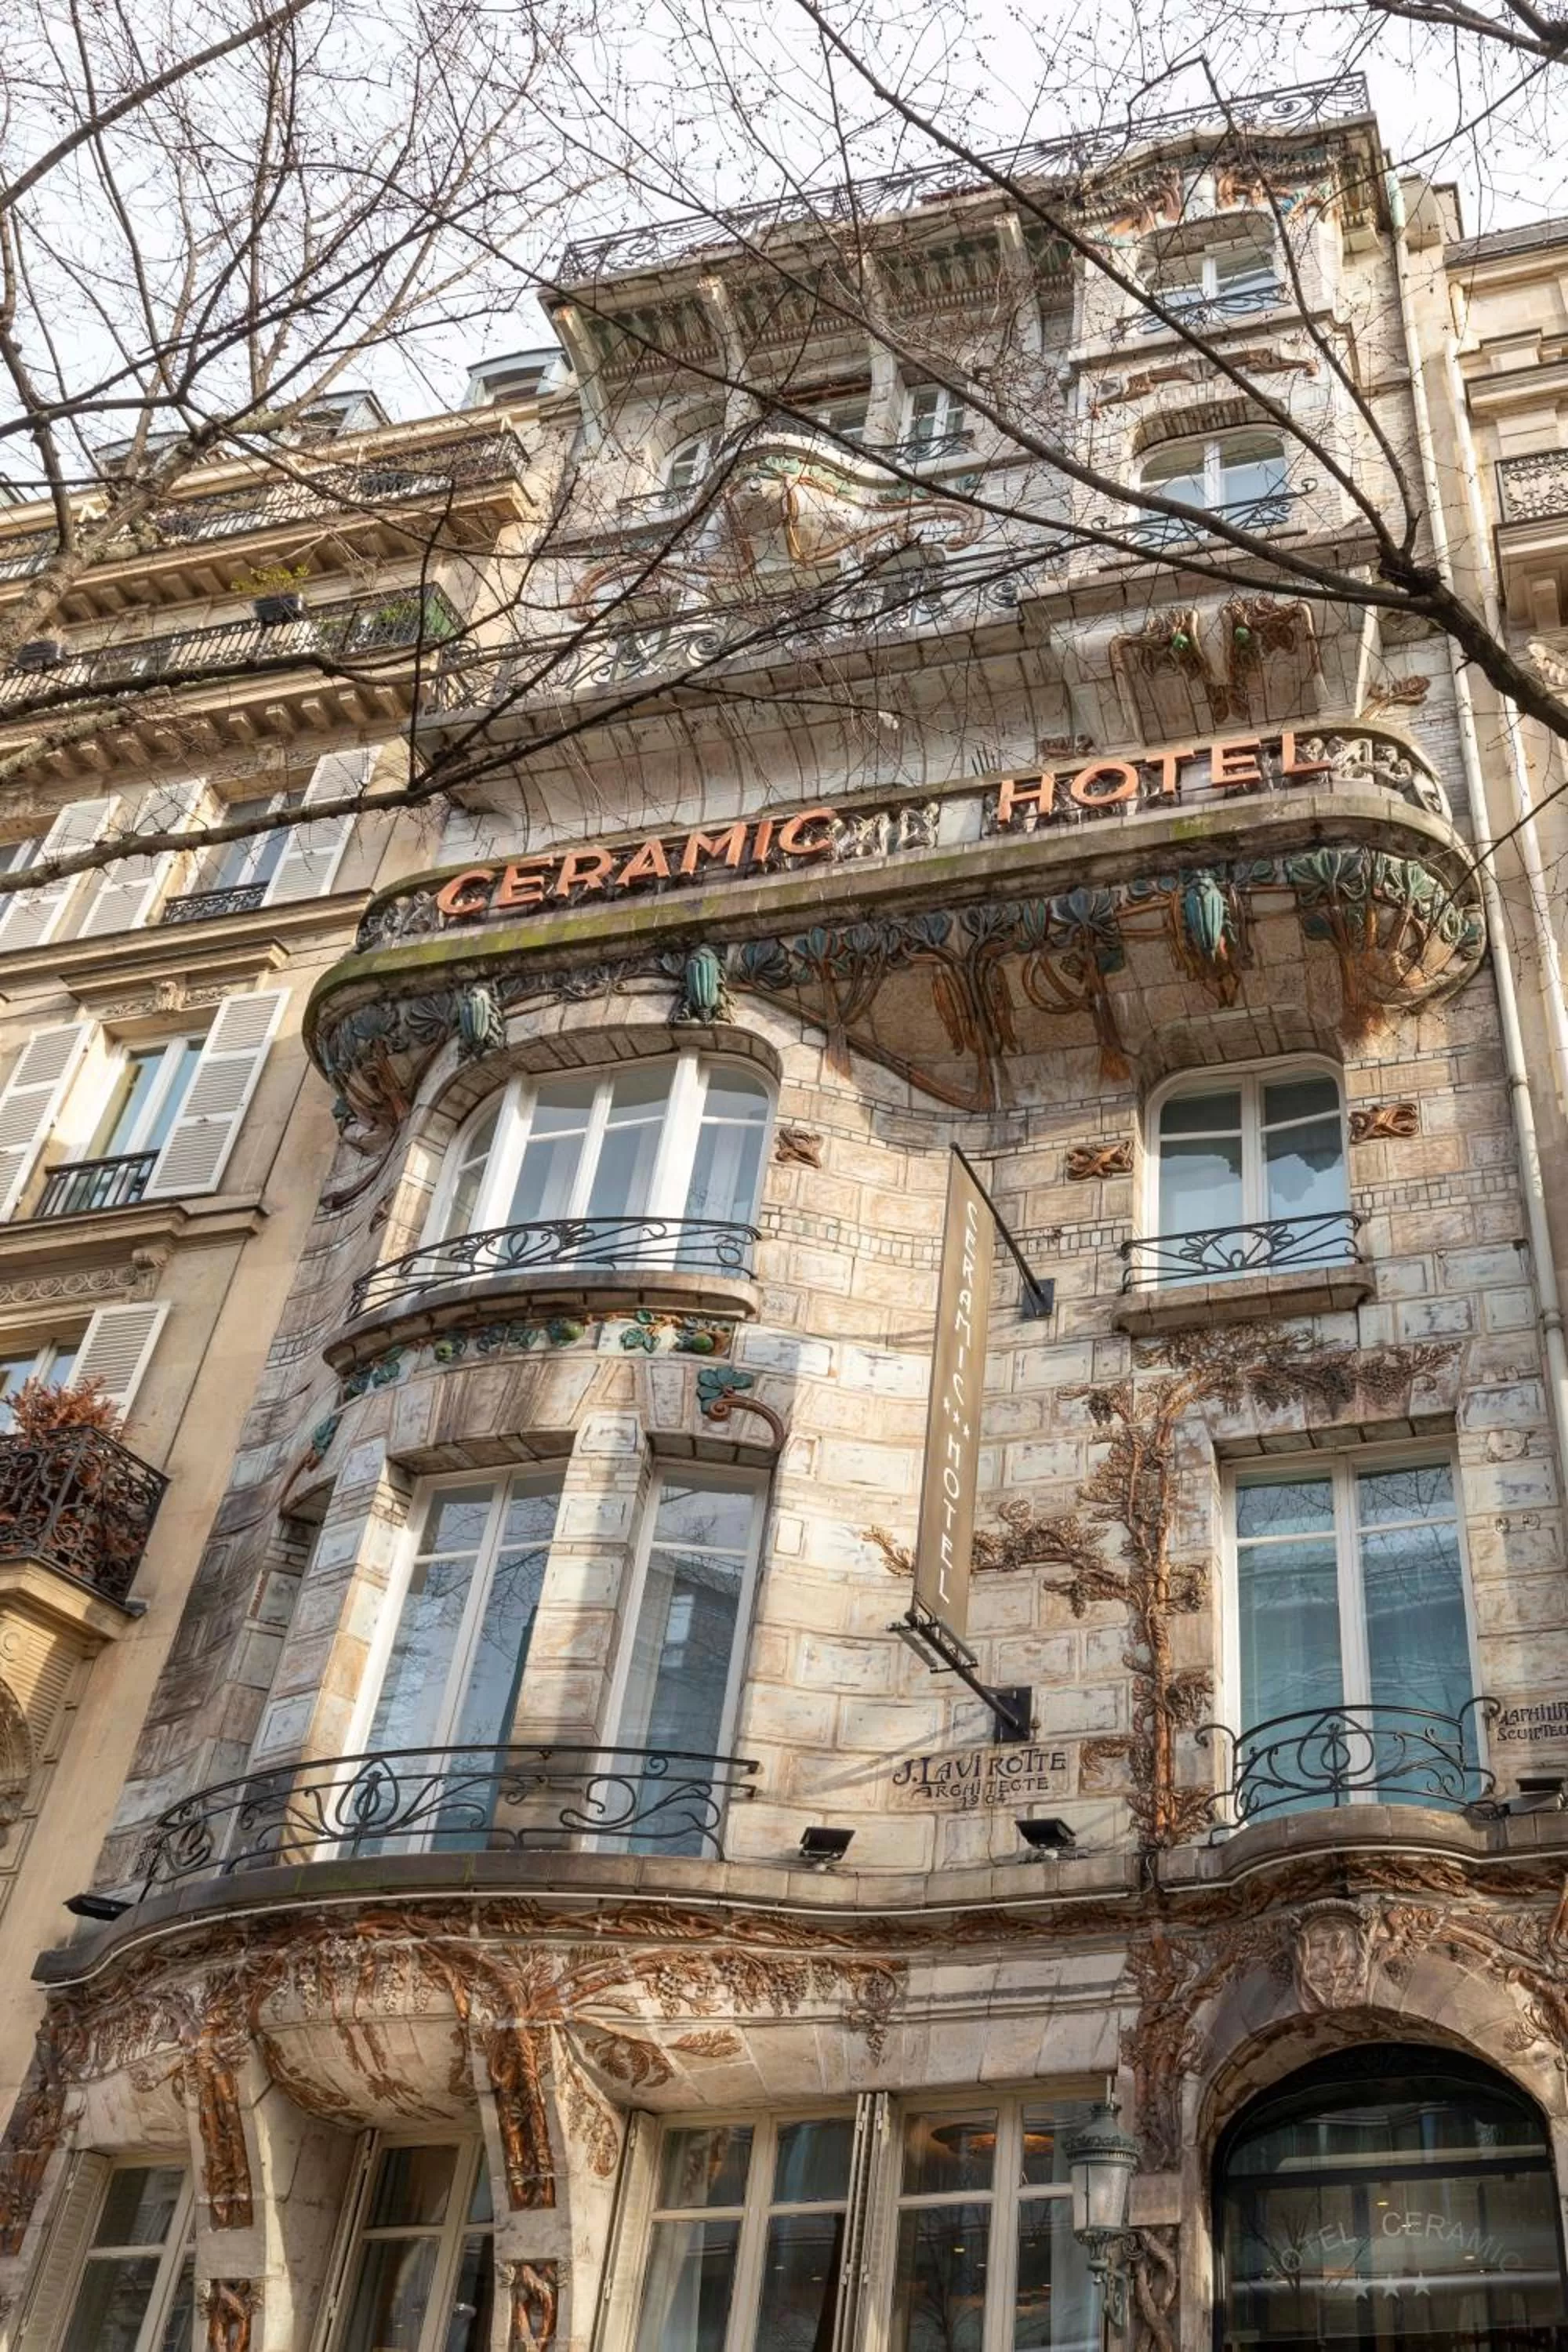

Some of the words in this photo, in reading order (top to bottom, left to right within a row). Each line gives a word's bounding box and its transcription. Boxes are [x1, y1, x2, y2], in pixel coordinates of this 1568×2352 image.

[435, 807, 838, 917] CERAMIC
[997, 731, 1332, 825] HOTEL
[952, 1200, 978, 1406] CERAMIC
[939, 1432, 961, 1605] HOTEL
[912, 1777, 1048, 1798] ARCHITECTE
[1381, 2212, 1522, 2273] CERAMIC
